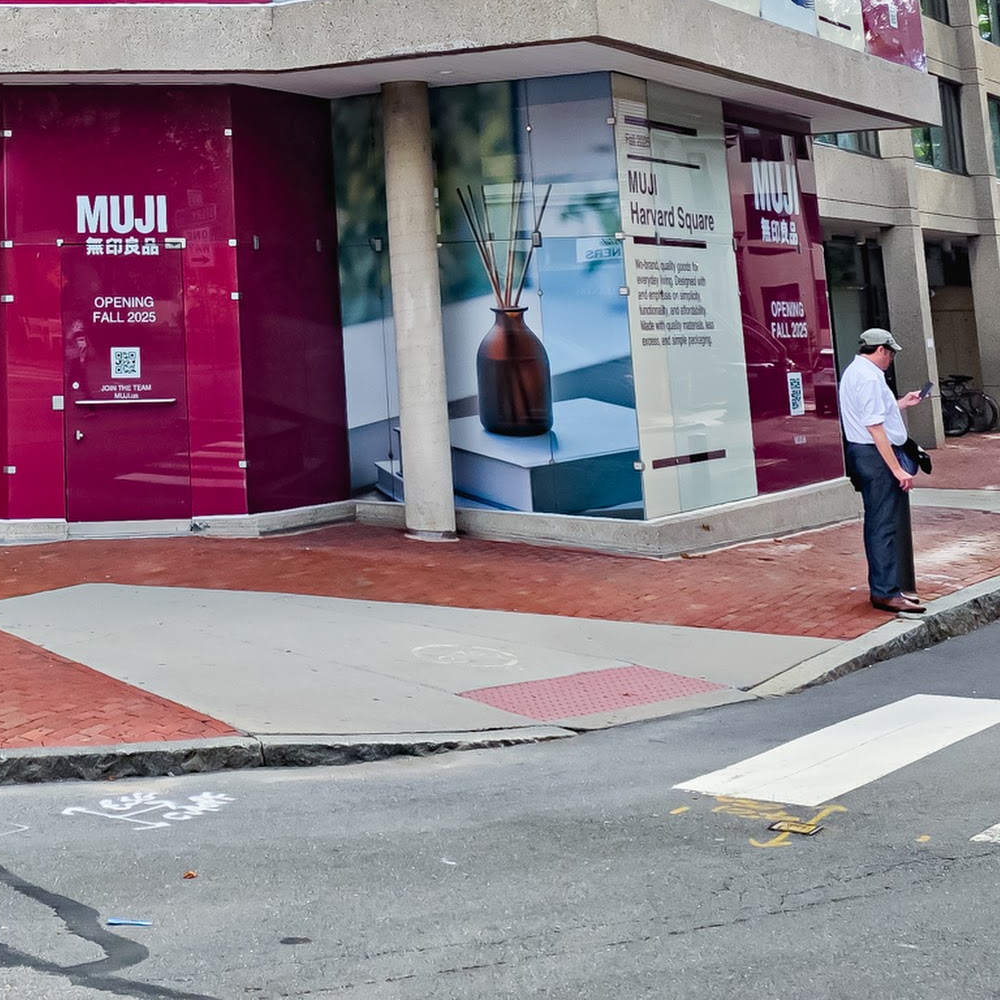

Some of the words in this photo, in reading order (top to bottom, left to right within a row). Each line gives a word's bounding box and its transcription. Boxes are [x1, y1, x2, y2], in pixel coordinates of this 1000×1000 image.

[628, 170, 657, 196] MUJI
[752, 157, 800, 215] MUJI
[76, 195, 168, 234] MUJI
[630, 201, 675, 227] Harvard
[677, 206, 715, 234] Square
[86, 236, 159, 256] 無印良品
[94, 297, 154, 308] OPENING
[771, 301, 804, 318] OPENING
[93, 312, 124, 323] FALL
[127, 312, 156, 323] 2025
[771, 322, 791, 338] FALL
[791, 322, 807, 338] 2025
